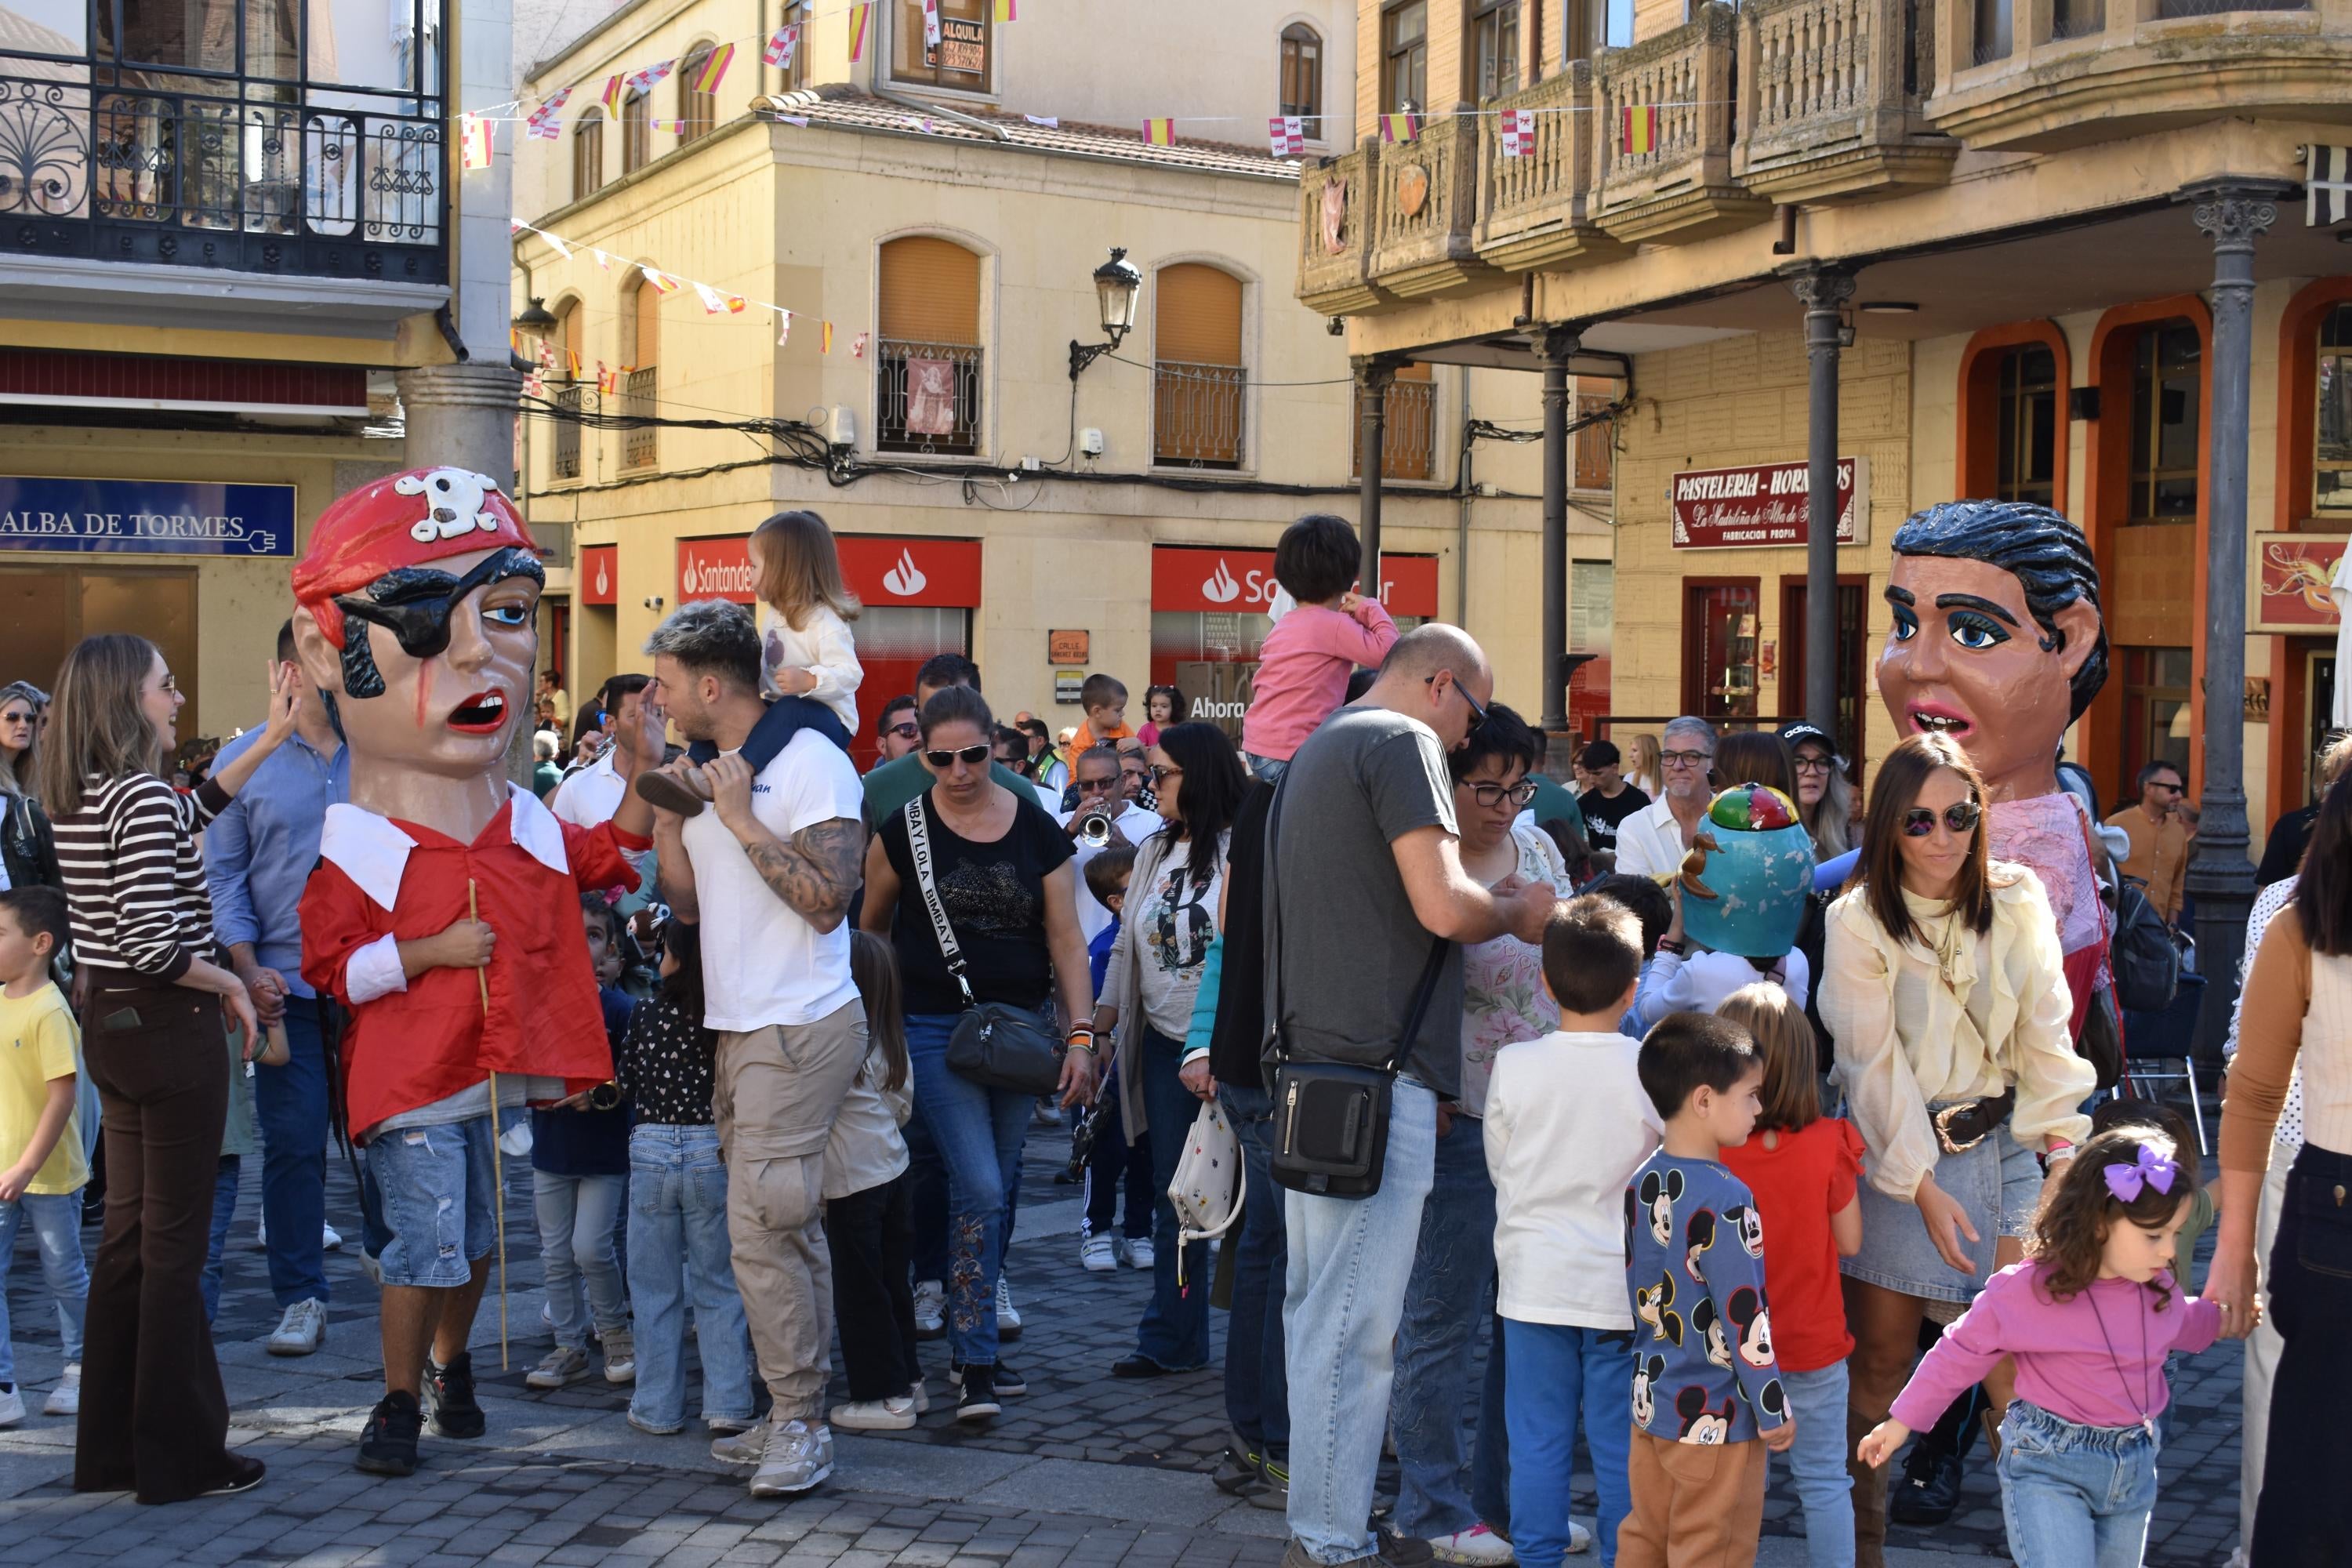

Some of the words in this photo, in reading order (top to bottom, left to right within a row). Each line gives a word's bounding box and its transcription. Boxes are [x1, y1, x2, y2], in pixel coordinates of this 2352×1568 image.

[943, 23, 984, 42] ALQUILA
[1677, 472, 1759, 501] PASTELERIA
[1, 510, 77, 534] ALBA
[84, 514, 122, 535] DE
[129, 514, 244, 538] TORMES
[1691, 504, 1708, 528] La
[1722, 531, 1766, 540] FABRICACION
[1770, 529, 1796, 539] PROPIA
[698, 557, 754, 593] Santande
[1191, 697, 1245, 717] Ahora
